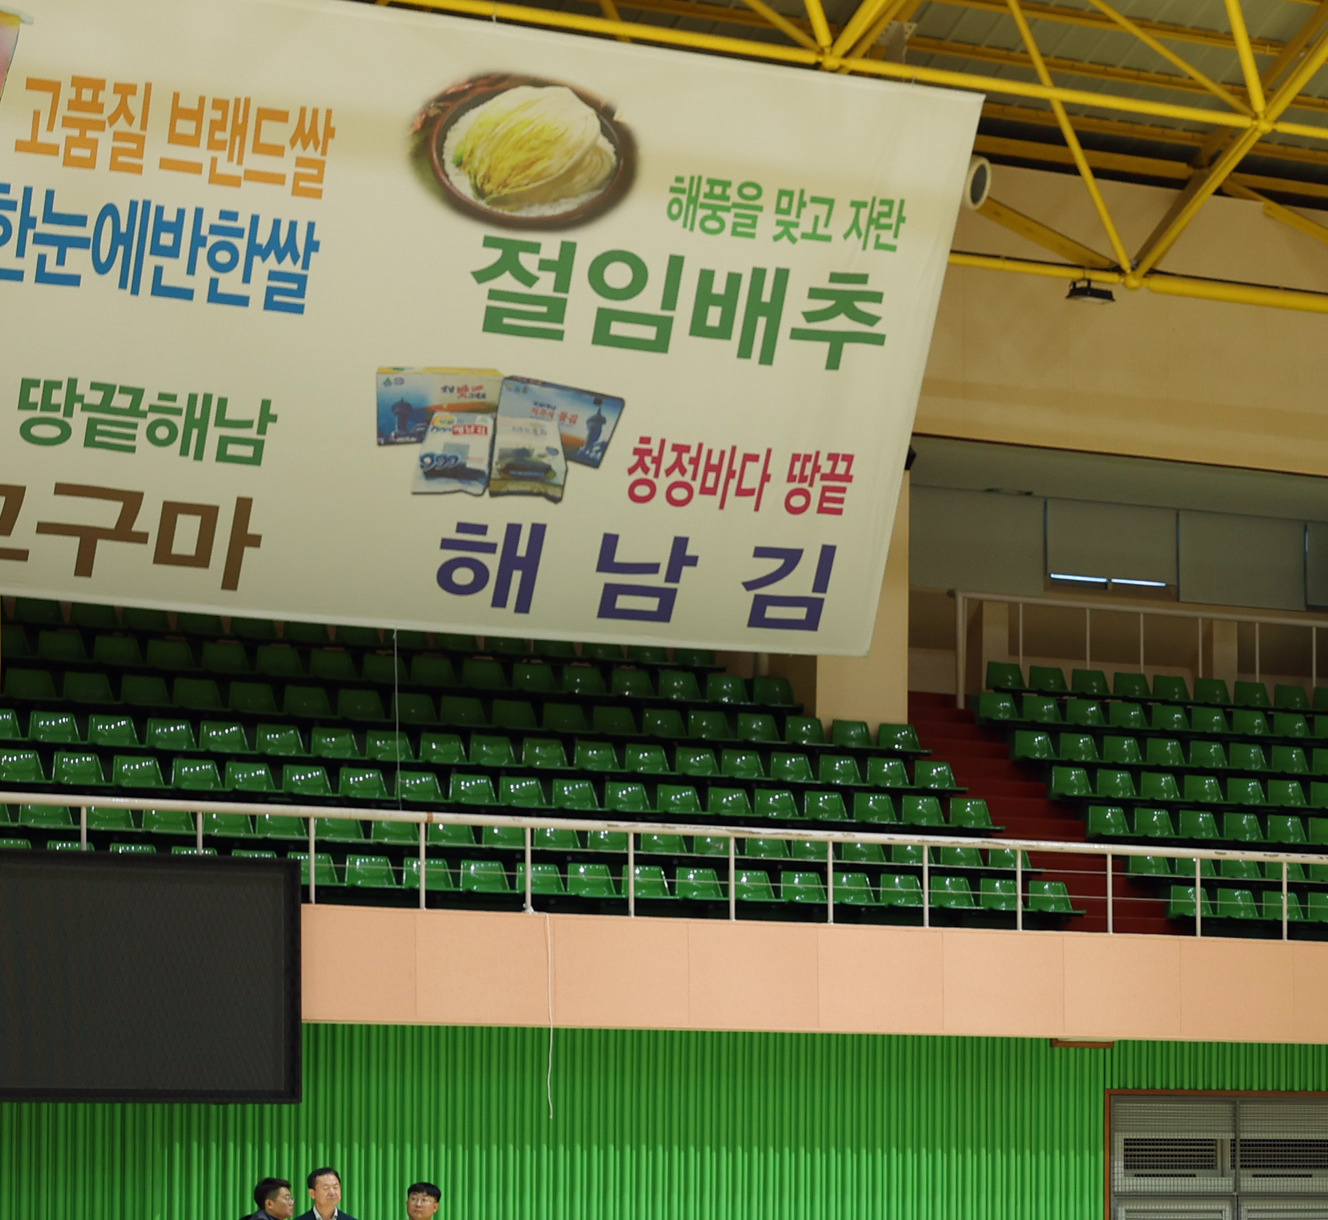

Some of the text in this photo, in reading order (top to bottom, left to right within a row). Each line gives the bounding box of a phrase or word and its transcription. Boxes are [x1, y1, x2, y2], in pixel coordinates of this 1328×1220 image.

[14, 75, 336, 200] 고품질 브랜드쌀
[665, 175, 906, 252] 해풍을 맞고 자란
[470, 234, 887, 371] 절임배추
[18, 377, 279, 467] 땅끝해남
[627, 435, 855, 516] 청정바다 땅끝
[0, 482, 263, 592] 구마
